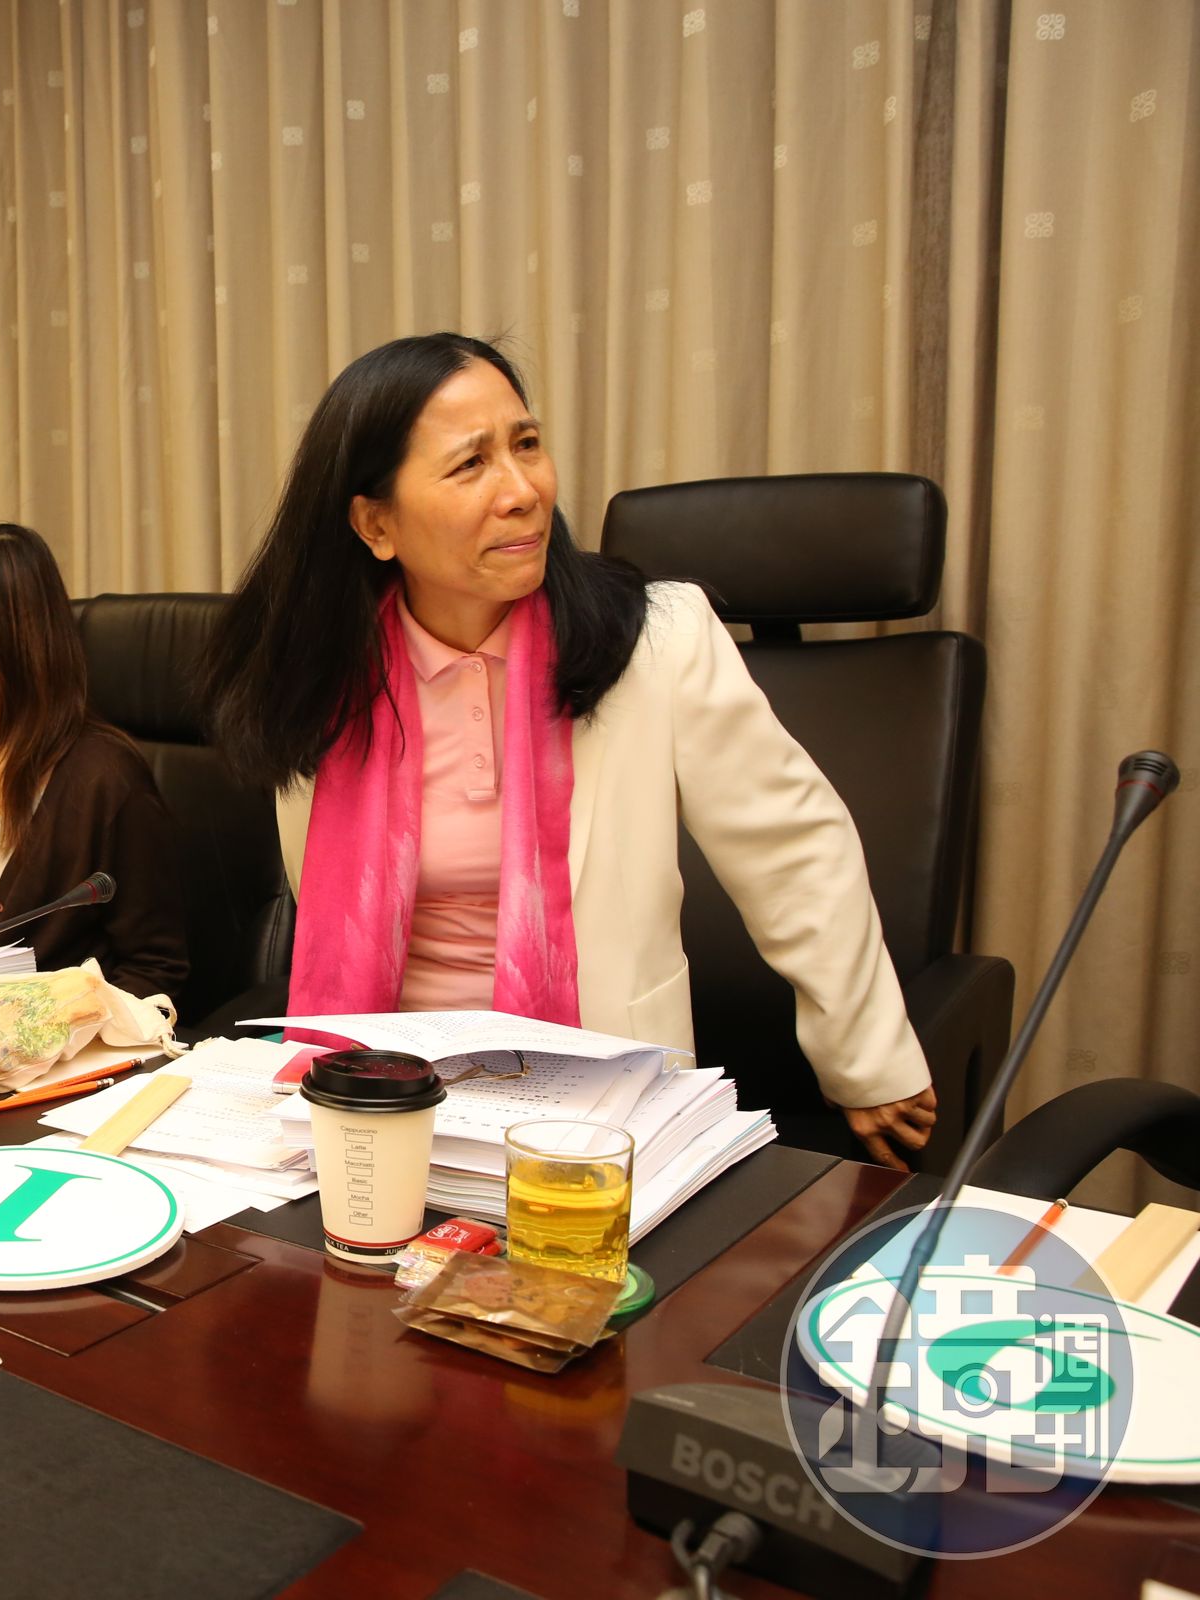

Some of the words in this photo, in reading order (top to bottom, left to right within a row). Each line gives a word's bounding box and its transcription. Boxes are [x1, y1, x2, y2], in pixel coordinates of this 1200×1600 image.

[340, 1125, 378, 1134] Cappuccino
[344, 1159, 375, 1167] Macchiato
[336, 1242, 350, 1252] TEA
[671, 1433, 836, 1532] BOSCH
